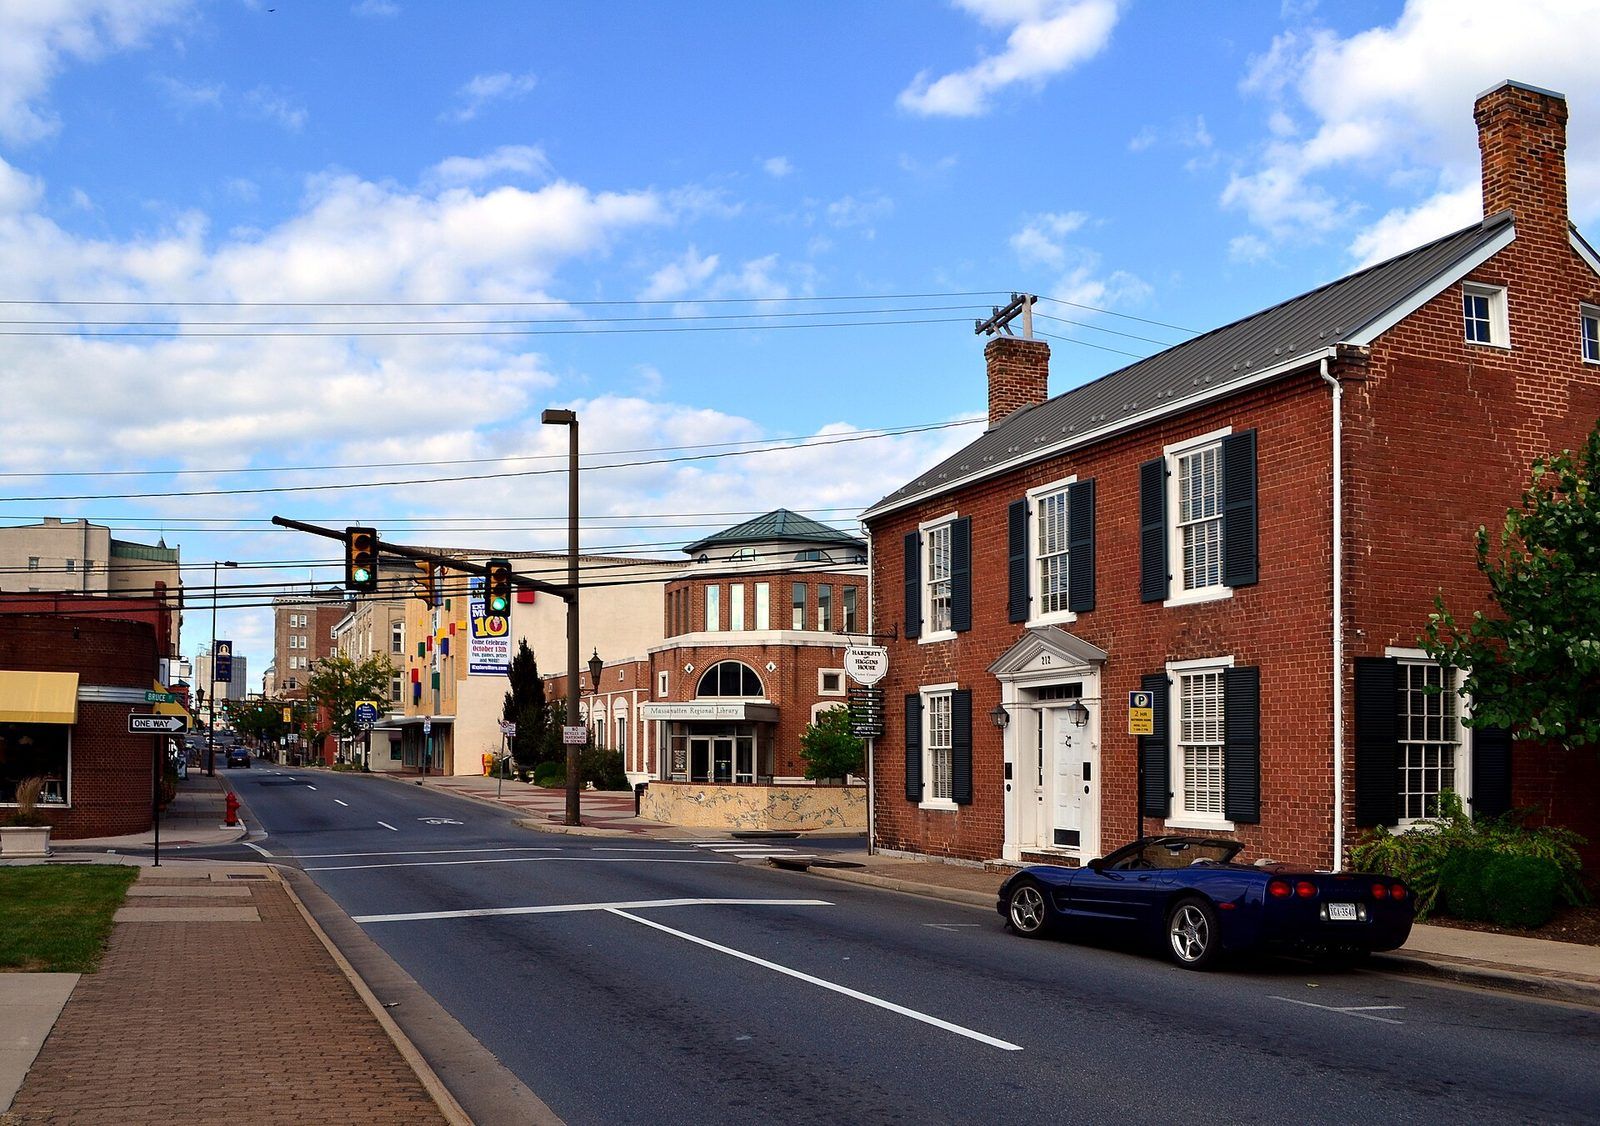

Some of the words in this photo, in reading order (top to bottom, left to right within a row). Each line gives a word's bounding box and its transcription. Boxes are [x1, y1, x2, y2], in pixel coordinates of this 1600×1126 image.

[474, 615, 507, 636] 10
[1041, 655, 1051, 665] 212
[147, 692, 166, 702] BRUCE
[1138, 695, 1145, 705] P
[690, 706, 714, 715] Regional
[717, 706, 738, 715] Library
[134, 719, 150, 728] ONE
[153, 720, 170, 728] WAY
